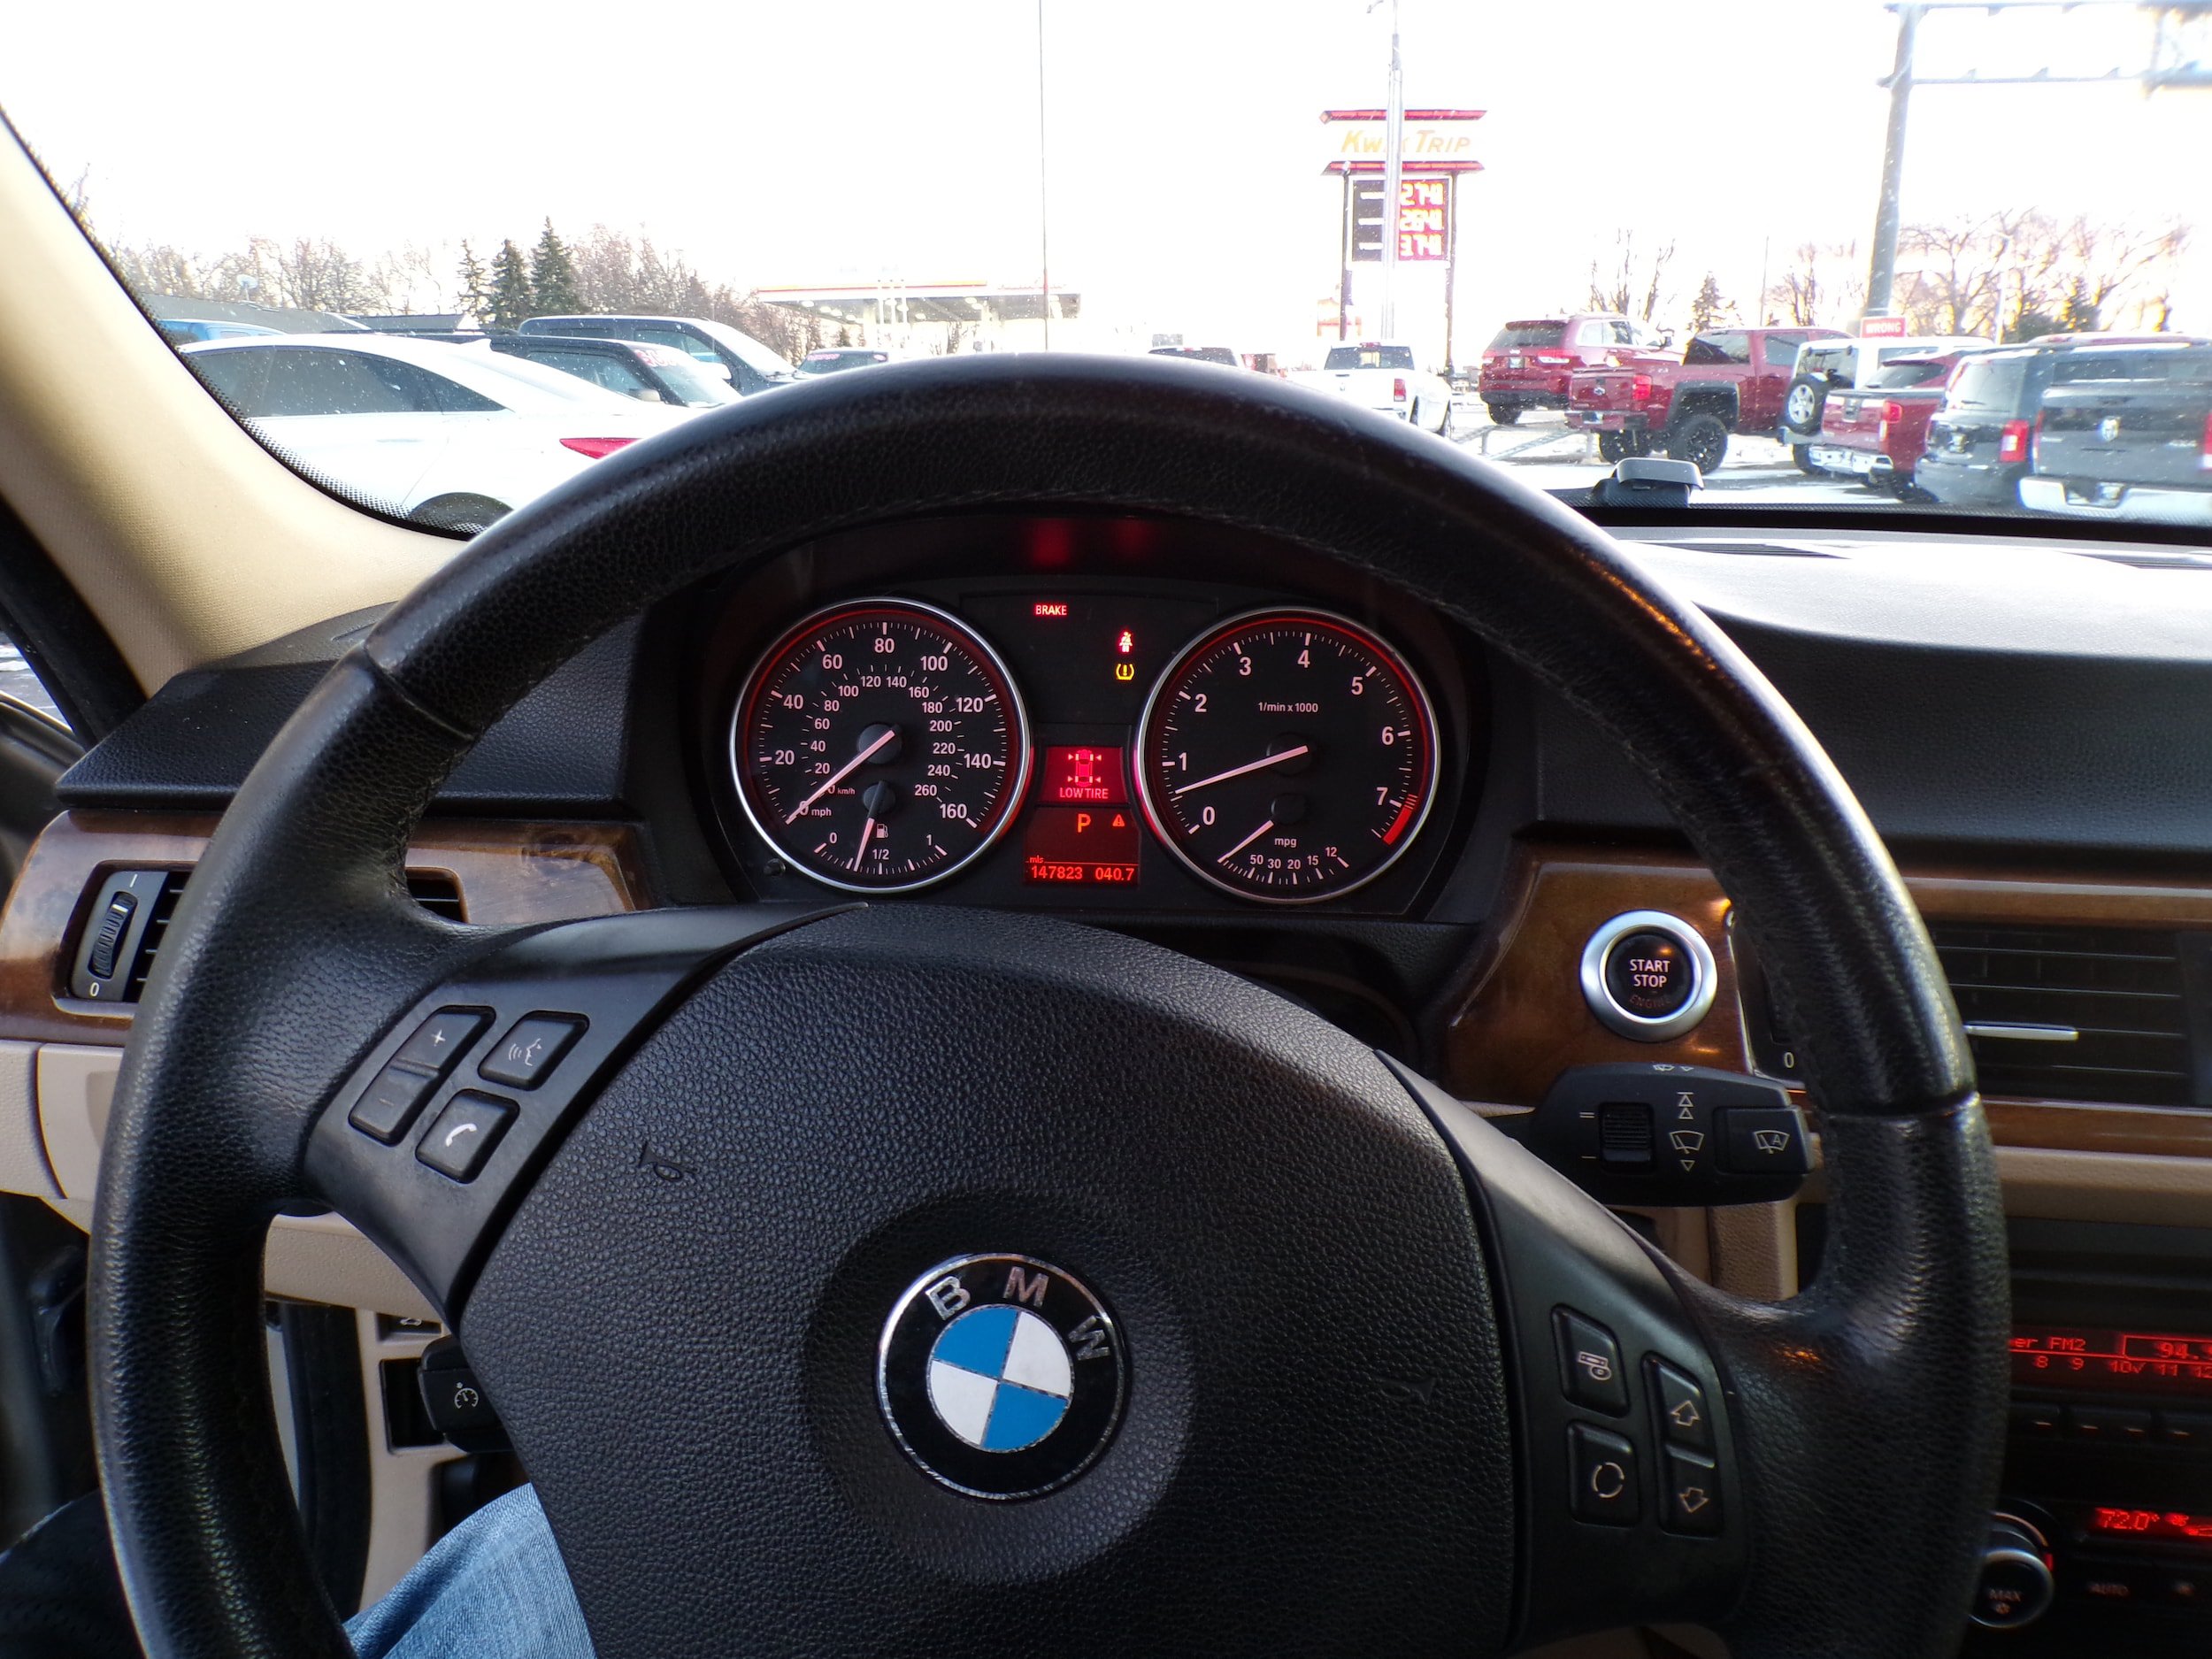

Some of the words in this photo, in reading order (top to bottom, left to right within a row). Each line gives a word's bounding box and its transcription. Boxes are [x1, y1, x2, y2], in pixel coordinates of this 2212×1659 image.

[1035, 604, 1068, 617] BRAKE
[873, 638, 895, 654] 80
[822, 654, 843, 670] 60
[920, 656, 949, 672] 100
[1297, 649, 1310, 668] 4
[1239, 657, 1252, 676] 3
[860, 675, 882, 688] 120
[886, 675, 908, 688] 140
[1351, 676, 1363, 696] 5
[838, 685, 860, 698] 100
[908, 686, 930, 699] 160
[783, 694, 804, 710] 40
[823, 700, 840, 712] 80
[922, 701, 943, 714] 180
[956, 696, 984, 713] 120
[1194, 693, 1208, 712] 2
[1258, 702, 1286, 713] 1/min
[1294, 703, 1319, 713] 1000
[814, 718, 831, 731] 60
[929, 720, 953, 733] 200
[1381, 726, 1394, 746] 6
[810, 740, 826, 753] 40
[932, 742, 956, 755] 220
[774, 749, 795, 766] 20
[963, 753, 993, 771] 140
[1179, 752, 1187, 772] 1
[814, 763, 831, 775] 20
[927, 764, 951, 778] 240
[914, 784, 938, 797] 260
[1059, 787, 1083, 798] LOW
[1085, 787, 1109, 800] TIRE
[1376, 787, 1389, 805] 7
[811, 807, 832, 818] mph
[940, 803, 967, 820] 160
[1202, 806, 1216, 826] 0
[1077, 813, 1092, 833] P
[829, 832, 838, 844] 0
[926, 834, 933, 846] 1
[1274, 836, 1297, 849] mpg
[872, 849, 890, 861] 1/2
[1325, 847, 1338, 858] 12
[1249, 854, 1264, 865] 50
[1267, 858, 1282, 869] 30
[1286, 858, 1302, 870] 20
[1307, 855, 1319, 866] 15
[1031, 865, 1083, 879] 147823
[1094, 867, 1134, 881] 040.7
[1629, 958, 1671, 973] START
[1633, 974, 1668, 988] STOP
[925, 1265, 1111, 1362] BMW
[2048, 1336, 2086, 1352] FM2
